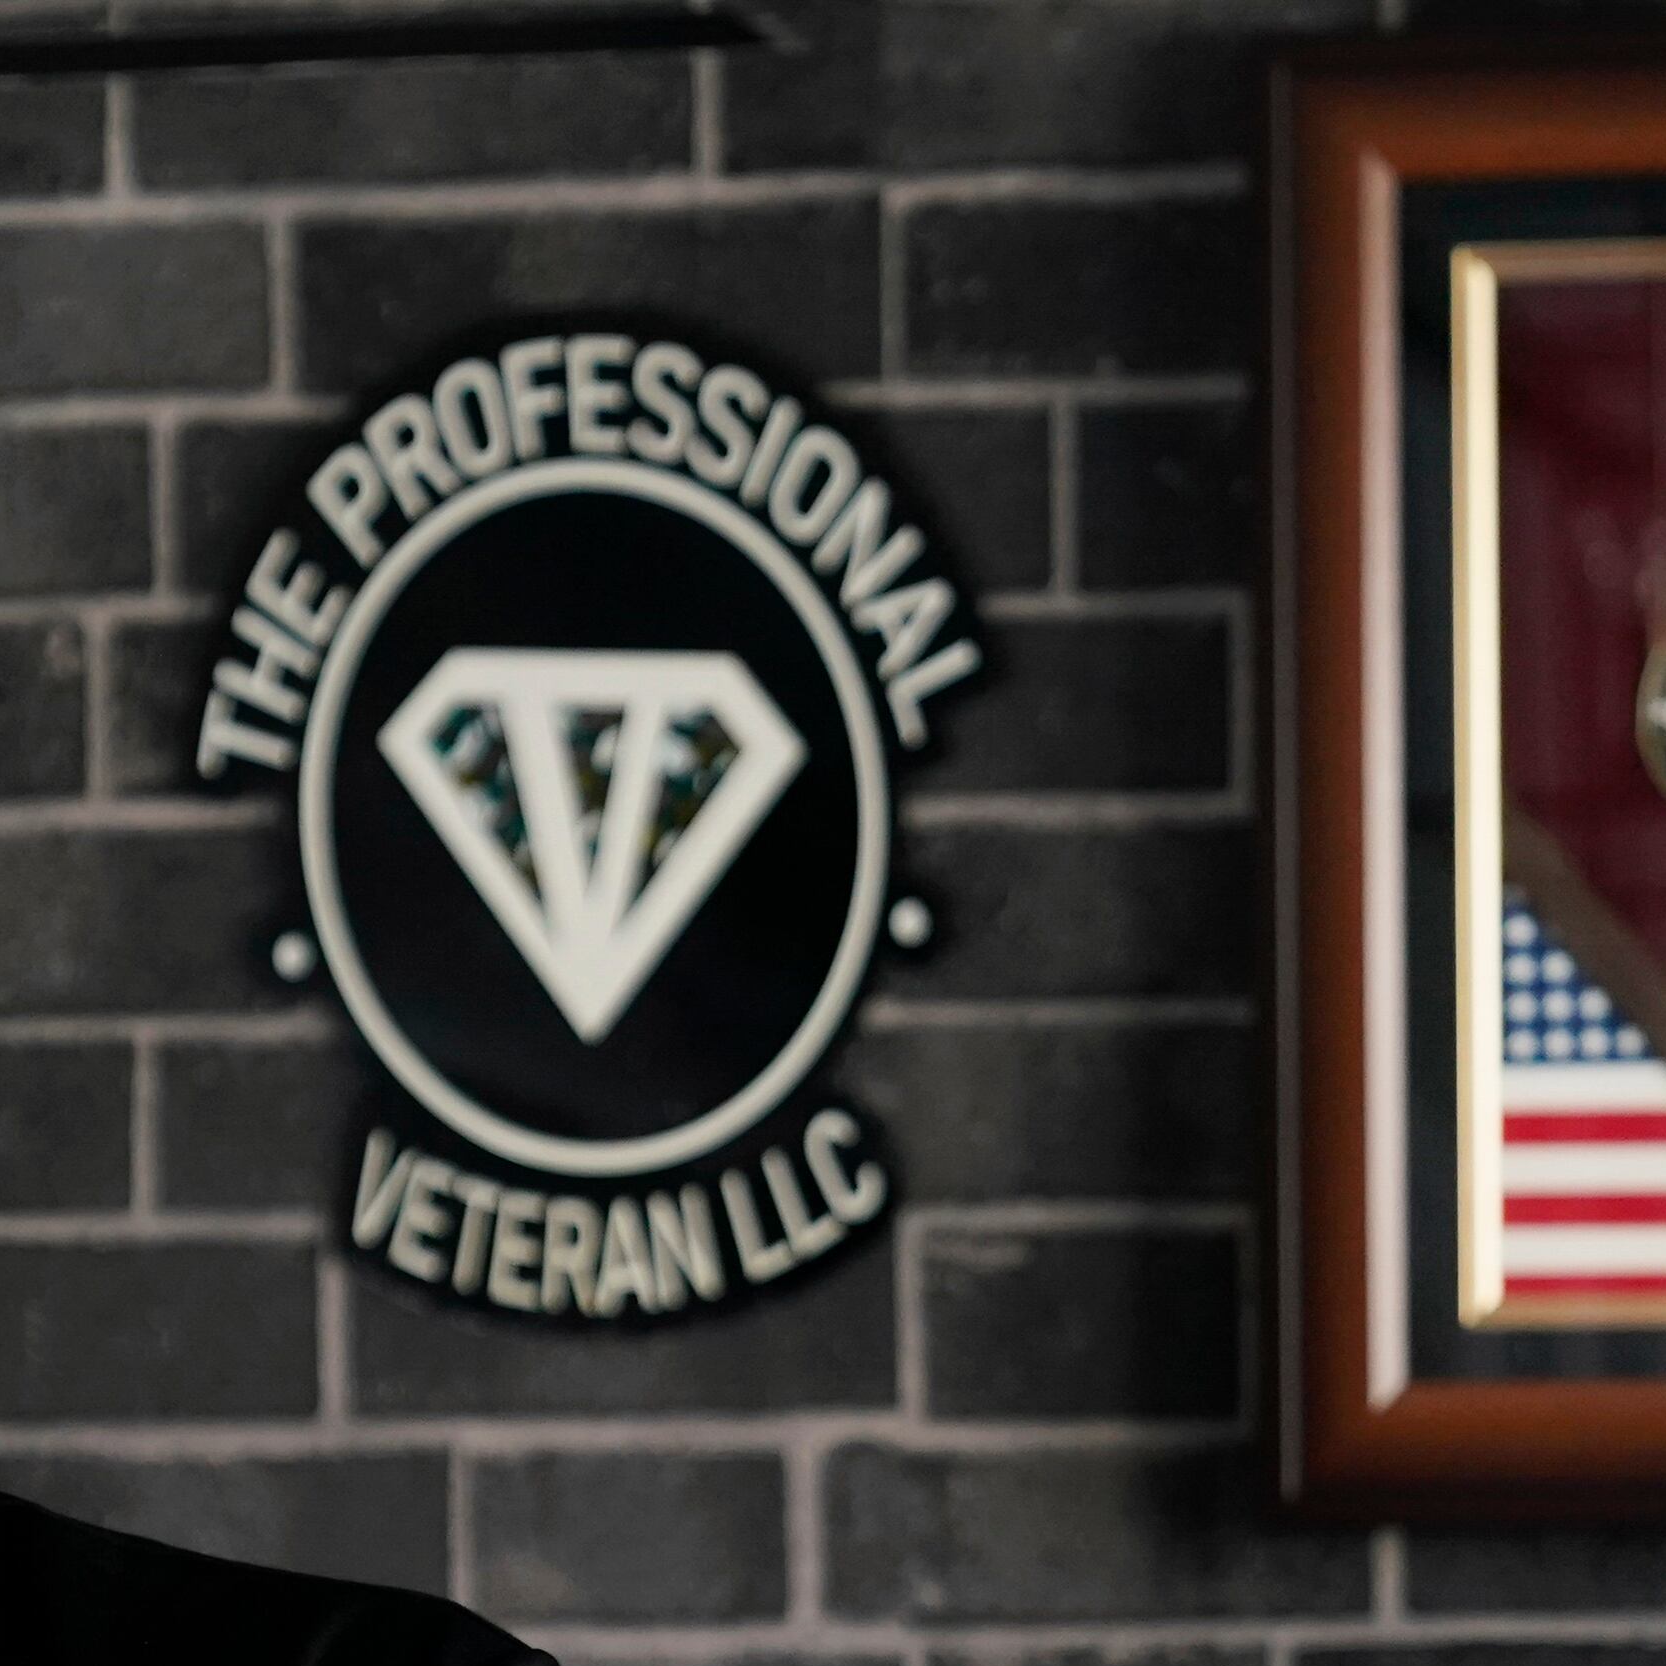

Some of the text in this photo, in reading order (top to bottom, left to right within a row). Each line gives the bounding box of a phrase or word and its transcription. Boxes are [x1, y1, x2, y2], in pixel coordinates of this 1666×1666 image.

[196, 333, 984, 779] THE PROFESSIONAL
[351, 1108, 887, 1317] VETERAN LLC
